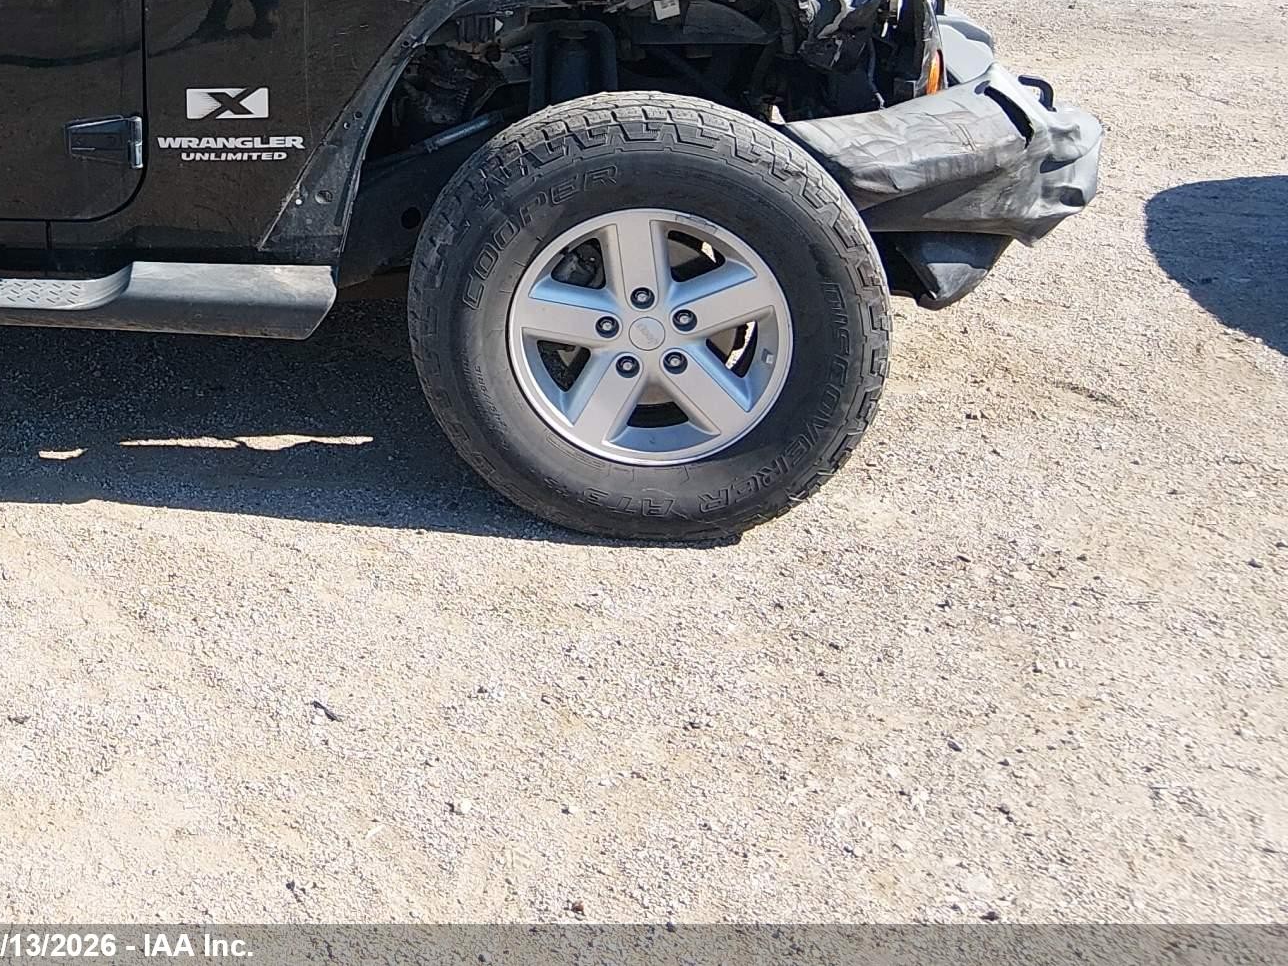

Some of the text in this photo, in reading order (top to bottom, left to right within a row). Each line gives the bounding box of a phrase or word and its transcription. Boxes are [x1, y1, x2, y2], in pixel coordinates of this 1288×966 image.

[158, 136, 305, 149] WRANGLER
[181, 152, 288, 161] UNLIMITED
[462, 165, 618, 310] COOPER
